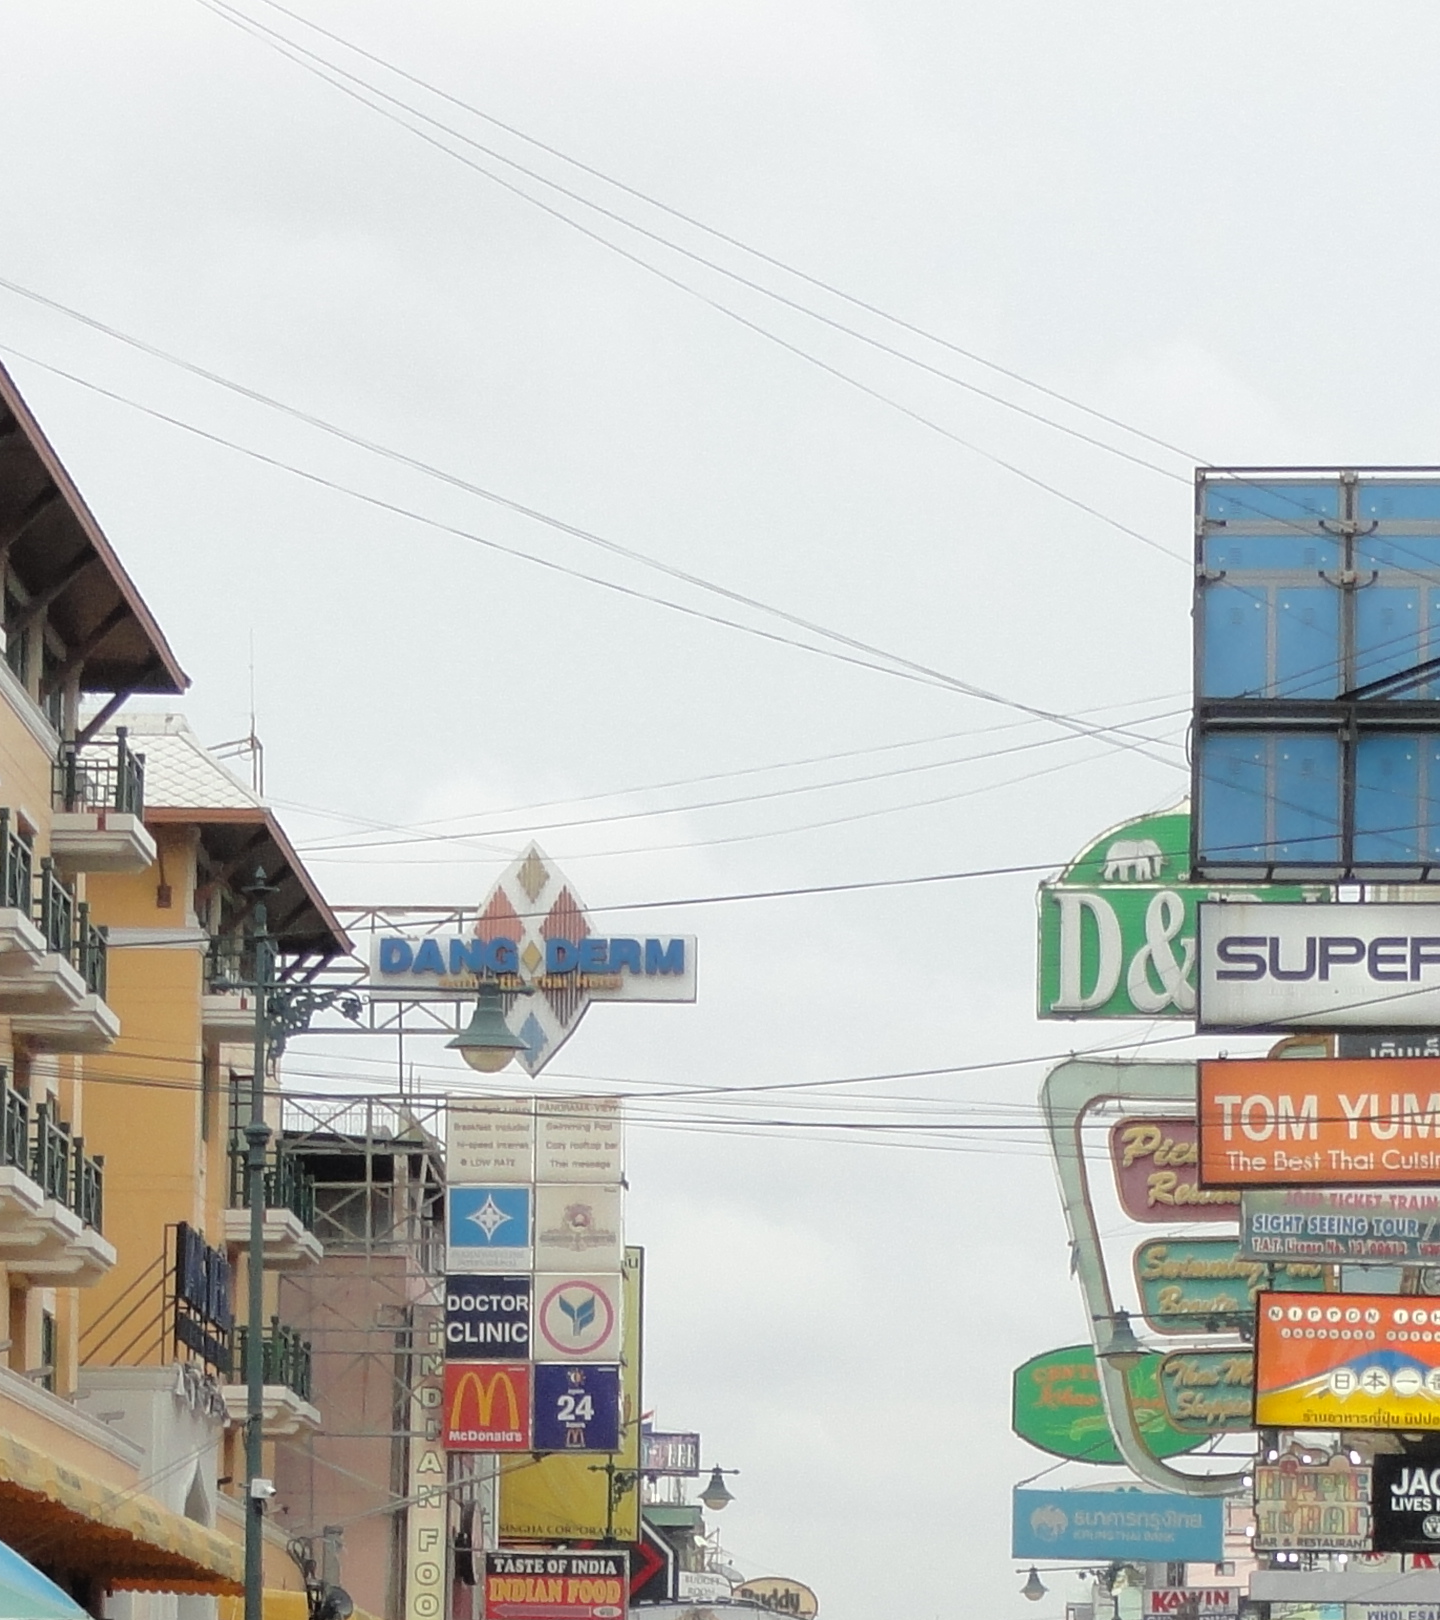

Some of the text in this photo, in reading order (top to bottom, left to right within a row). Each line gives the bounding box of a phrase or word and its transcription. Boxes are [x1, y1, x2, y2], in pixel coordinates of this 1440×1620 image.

[379, 936, 685, 976] DANG DERM
[1214, 1094, 1318, 1142] TOM
[1226, 1150, 1267, 1173] The
[1273, 1151, 1321, 1172] Best
[1327, 1149, 1374, 1171] Thai
[1330, 1193, 1382, 1209] TICKET
[1389, 1194, 1439, 1211] TRAIN
[1252, 1214, 1304, 1234] SIGHT
[1307, 1214, 1368, 1236] SEEING
[1372, 1216, 1420, 1239] TOUR
[447, 1294, 529, 1313] DOCTOR
[1269, 1307, 1379, 1324] NIPPON
[446, 1323, 529, 1344] CLINIC
[557, 1395, 595, 1422] 24
[1302, 1408, 1400, 1428] ร้านอาหารญี่ปุ่น
[448, 1429, 523, 1443] McDonald's
[1390, 1497, 1433, 1512] LIVES
[500, 1525, 543, 1535] SINGHA
[1297, 1538, 1368, 1549] RESTAURANT
[494, 1558, 617, 1575] TASTE OF INDIA
[488, 1577, 622, 1605] INDIAN FOOD
